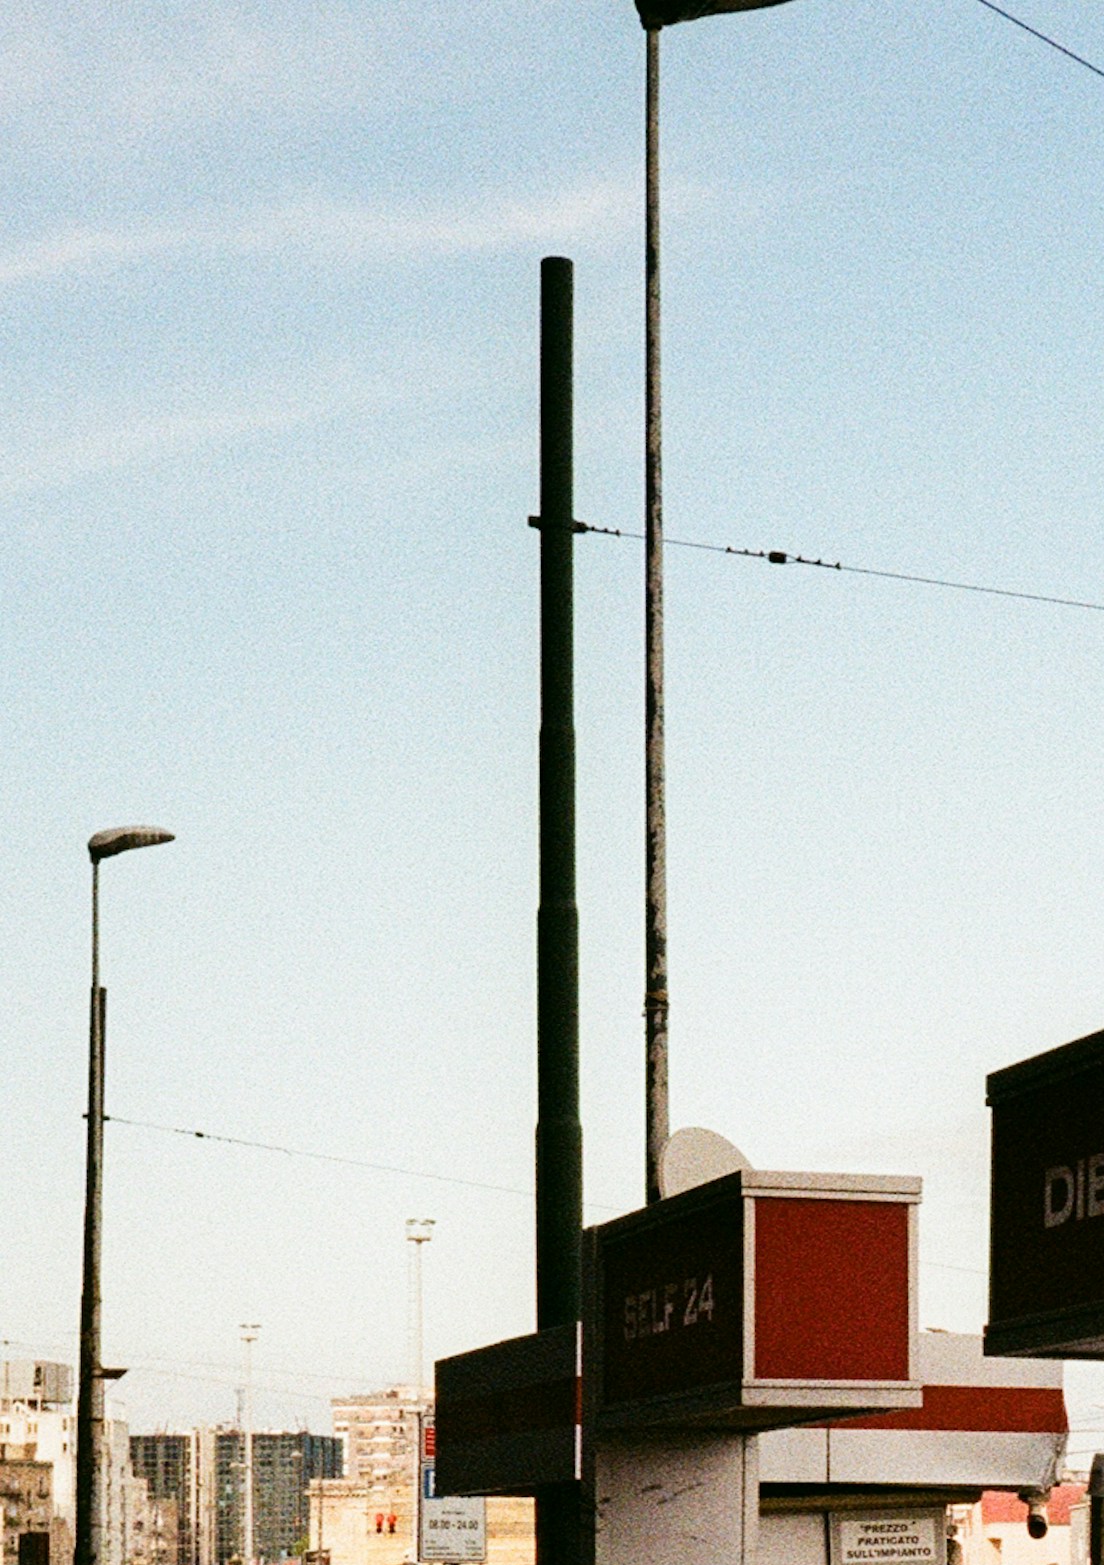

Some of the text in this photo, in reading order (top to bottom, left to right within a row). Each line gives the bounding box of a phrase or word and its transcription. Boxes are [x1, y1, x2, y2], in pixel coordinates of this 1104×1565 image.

[683, 1273, 715, 1326] 24
[857, 1535, 919, 1546] PRATICATO
[846, 1547, 931, 1559] SULL'IMPIANTO
